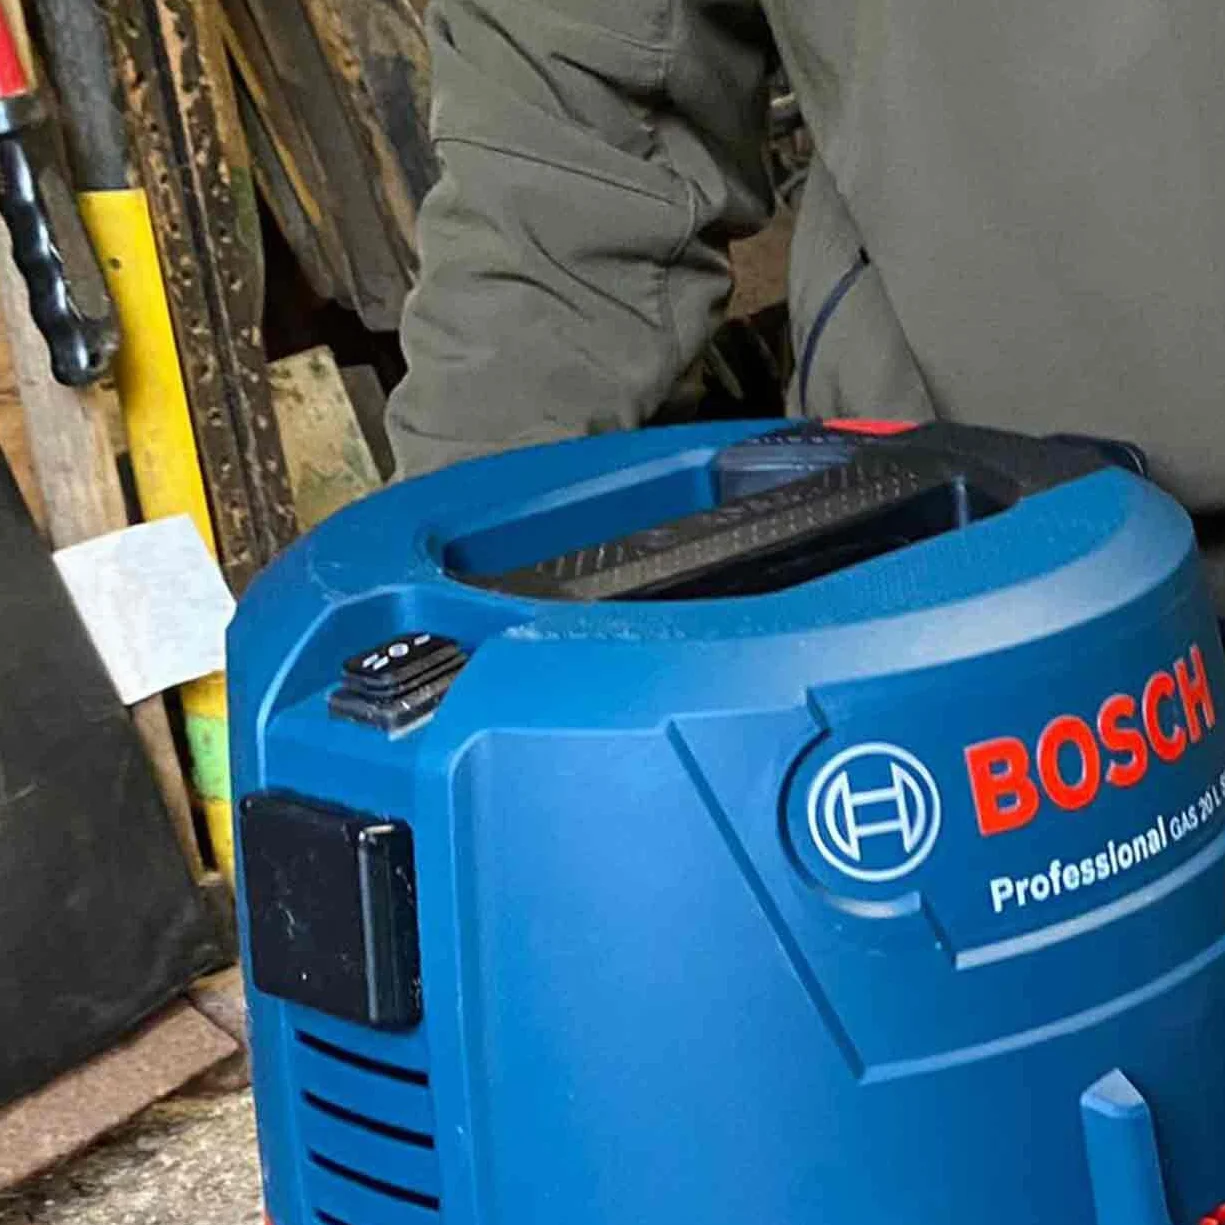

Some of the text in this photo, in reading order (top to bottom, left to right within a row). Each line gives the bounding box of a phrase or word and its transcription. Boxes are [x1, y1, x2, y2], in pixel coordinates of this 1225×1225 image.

[964, 643, 1216, 837] BOSCH
[989, 815, 1168, 913] Professional
[1169, 804, 1198, 841] GAS
